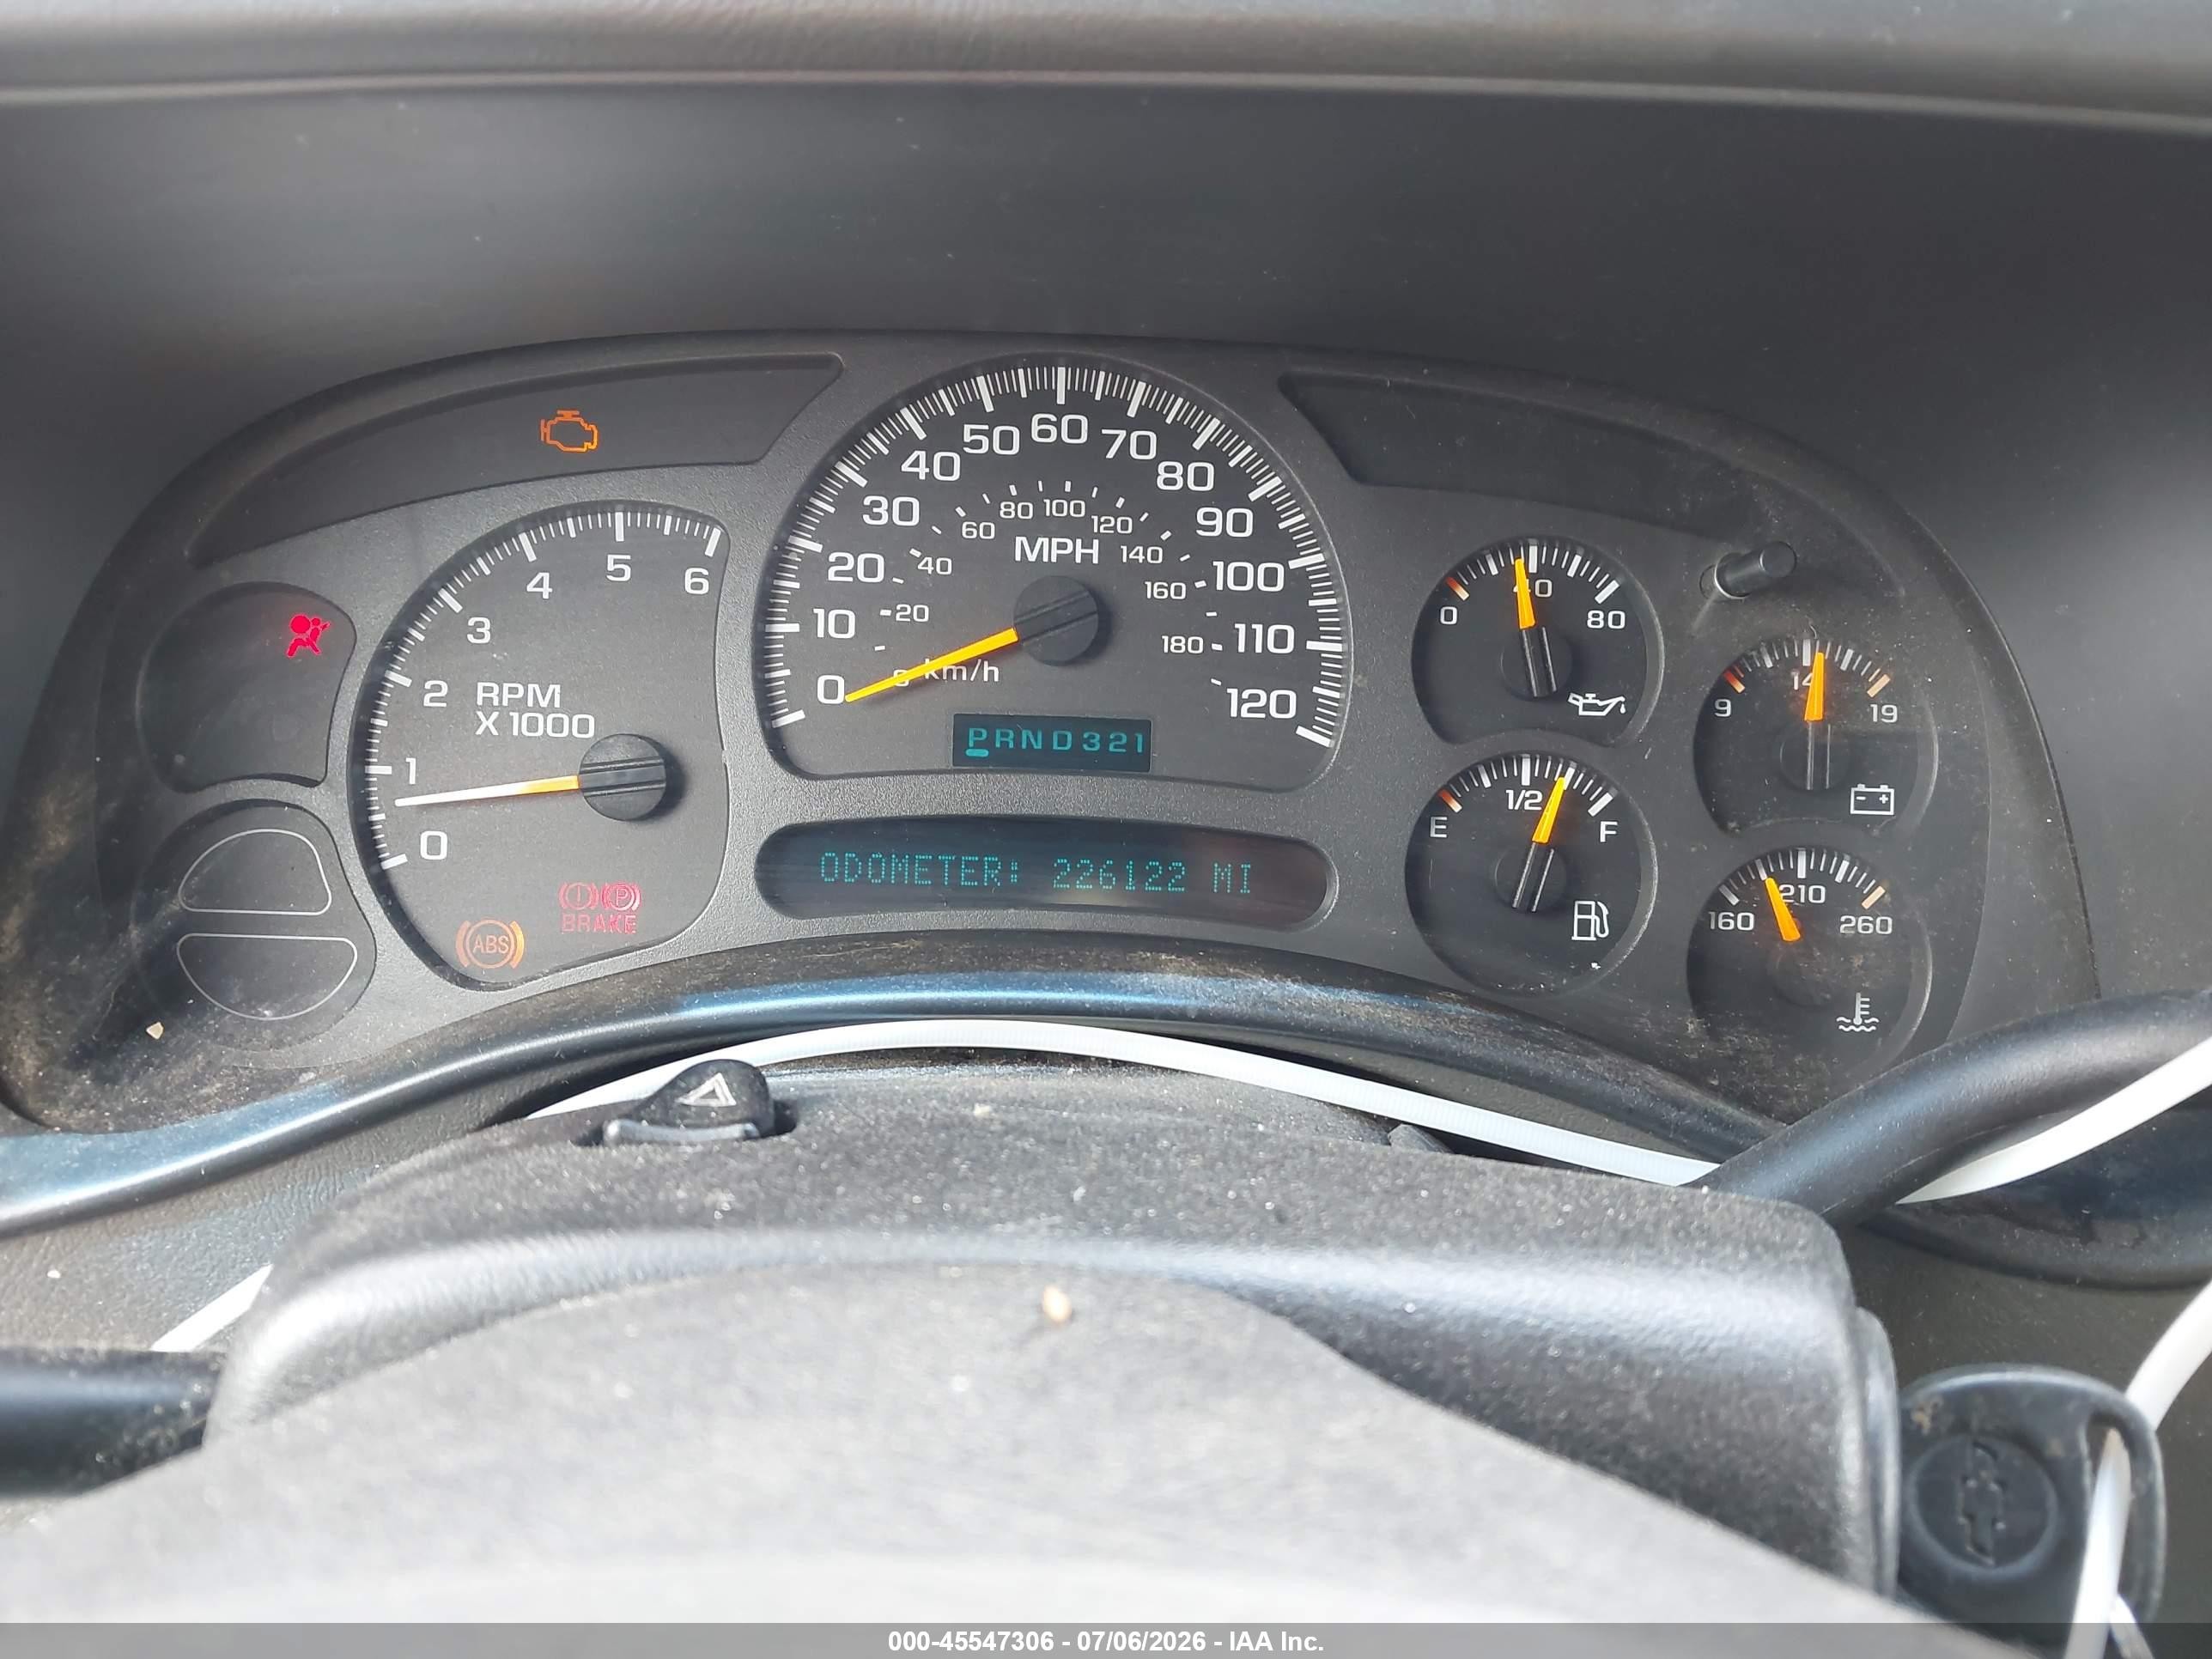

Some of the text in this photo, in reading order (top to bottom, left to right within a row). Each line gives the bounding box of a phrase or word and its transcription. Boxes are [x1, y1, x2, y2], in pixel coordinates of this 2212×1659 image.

[963, 423, 1020, 456] 50
[1030, 413, 1088, 444] 60
[1101, 428, 1158, 460] 70
[901, 450, 961, 482] 40
[1156, 460, 1215, 492] 80
[862, 495, 921, 526] 30
[999, 501, 1034, 520] 80
[1042, 498, 1086, 518] 100
[961, 521, 996, 540] 60
[1091, 514, 1133, 534] 120
[1195, 507, 1254, 538] 90
[1014, 536, 1099, 564] MPH
[1120, 545, 1164, 564] 140
[606, 554, 632, 583] 5
[827, 551, 885, 584] 20
[916, 556, 953, 575] 40
[1212, 560, 1285, 592] 100
[526, 572, 553, 599] 4
[684, 567, 710, 596] 6
[1144, 580, 1187, 600] 160
[812, 608, 856, 640] 10
[895, 604, 930, 623] 20
[1439, 606, 1458, 625] 0
[1586, 610, 1626, 629] 80
[466, 616, 492, 644] 3
[1234, 623, 1295, 654] 110
[1161, 635, 1204, 654] 180
[924, 658, 1000, 682] km/h
[422, 679, 449, 708] 2
[476, 681, 562, 708] RPM
[817, 674, 846, 705] 0
[1226, 688, 1297, 719] 120
[1714, 698, 1732, 718] 9
[1869, 703, 1899, 723] 19
[404, 757, 417, 784] 1
[1505, 789, 1543, 811] 1/2
[1429, 817, 1448, 838] E
[1599, 820, 1619, 842] F
[419, 830, 449, 860] 0
[819, 851, 1253, 894] ODOMETER: 226122 MI
[1778, 884, 1826, 903] 210
[562, 913, 636, 934] BRAKE
[1708, 911, 1755, 932] 160
[1839, 915, 1893, 935] 260
[472, 934, 510, 956] ABS
